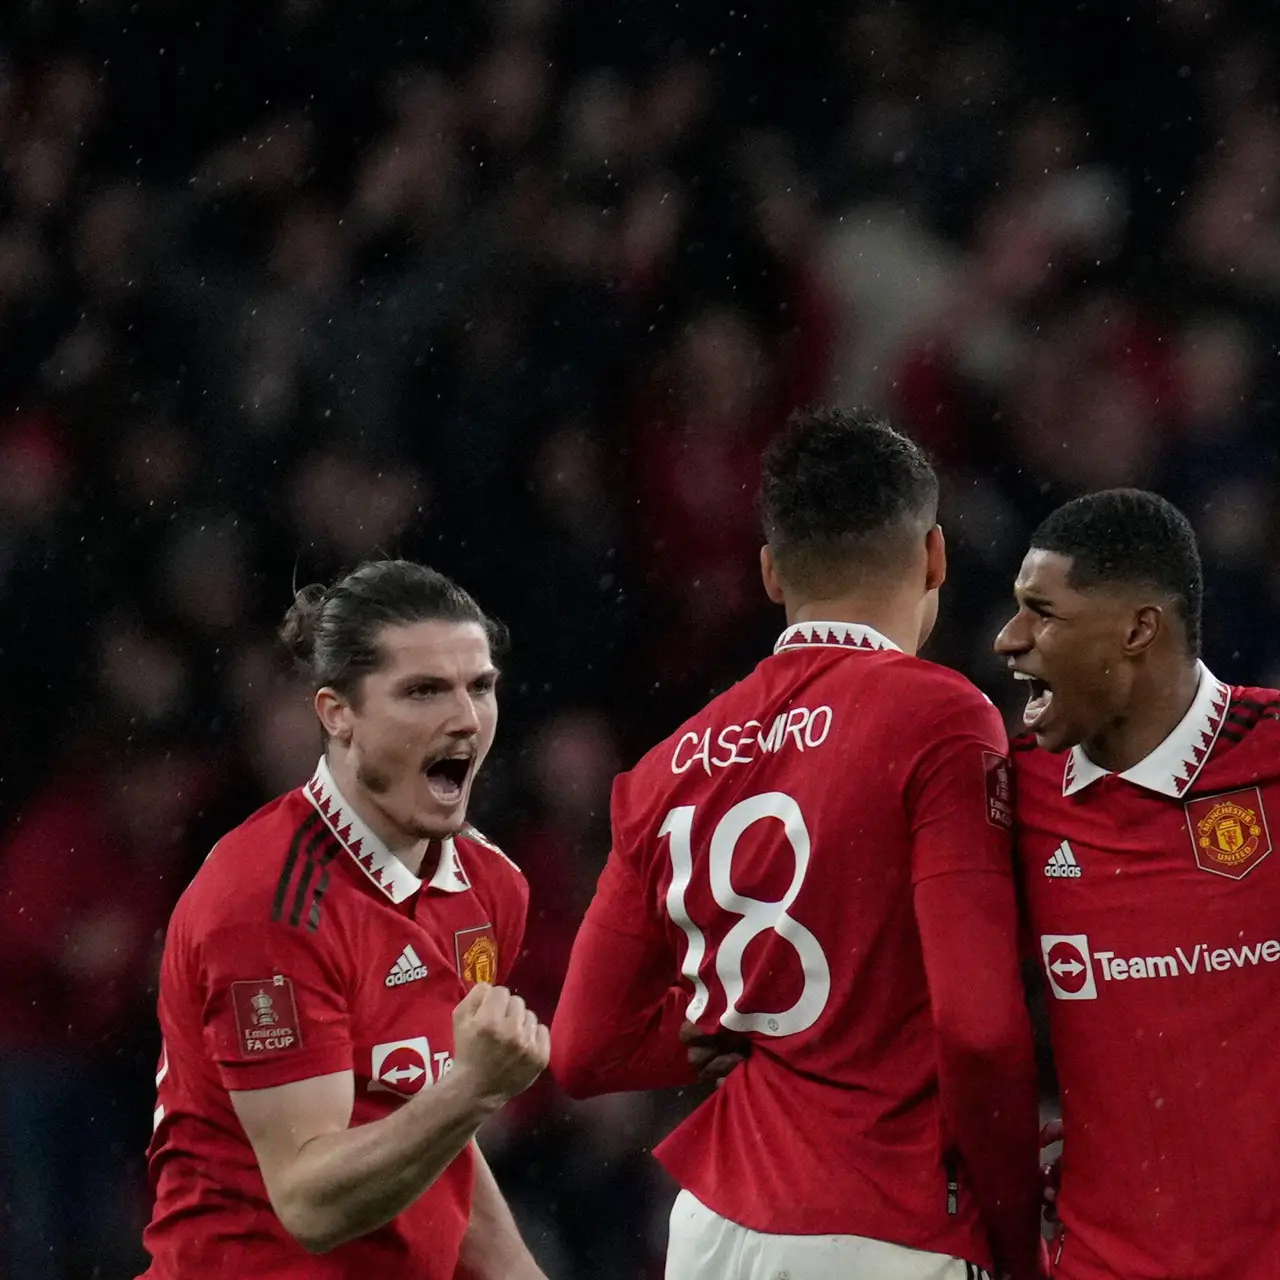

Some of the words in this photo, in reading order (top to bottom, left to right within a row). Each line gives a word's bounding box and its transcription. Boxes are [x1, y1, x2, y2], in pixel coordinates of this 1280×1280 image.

[671, 706, 833, 777] CASEMIRO
[1202, 806, 1252, 832] MANCHESTER
[1217, 846, 1252, 861] UNITED
[1044, 863, 1082, 878] adidas
[657, 791, 831, 1036] 18
[384, 964, 428, 988] adidas
[246, 1039, 264, 1051] FA
[265, 1036, 294, 1049] CUP
